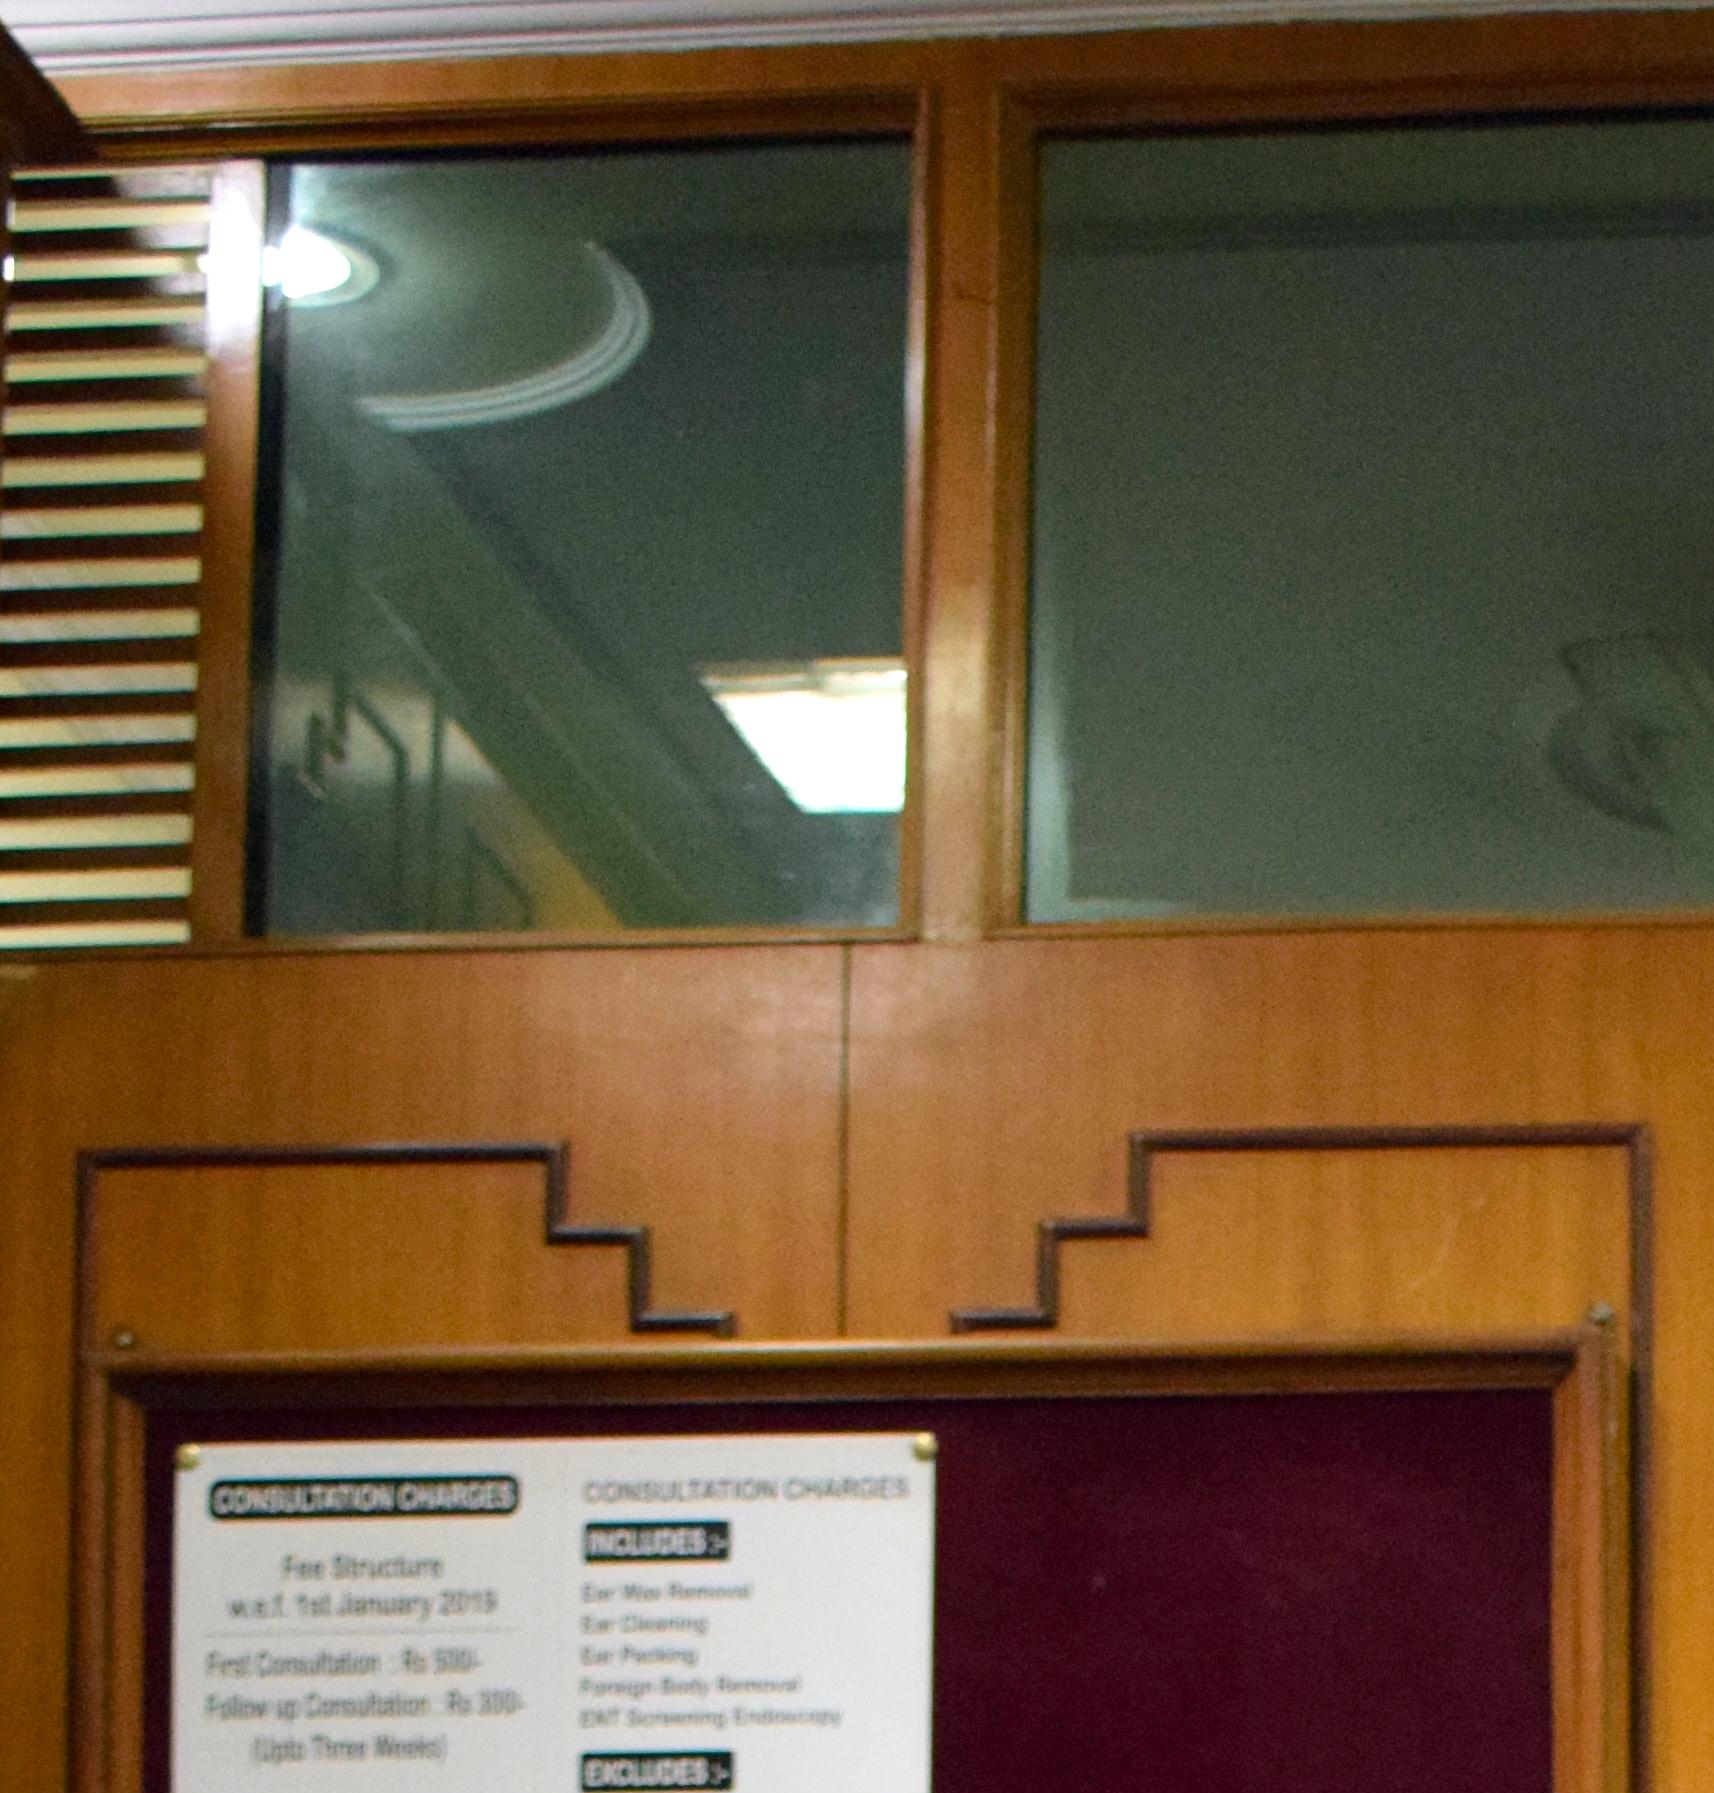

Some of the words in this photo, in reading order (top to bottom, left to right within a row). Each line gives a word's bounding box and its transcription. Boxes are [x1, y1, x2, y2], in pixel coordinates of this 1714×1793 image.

[582, 1478, 778, 1503] CONSULTATION
[784, 1475, 911, 1501] CHARGES
[282, 1554, 324, 1579] Fee
[332, 1553, 443, 1578] Structure
[337, 1593, 434, 1622] January
